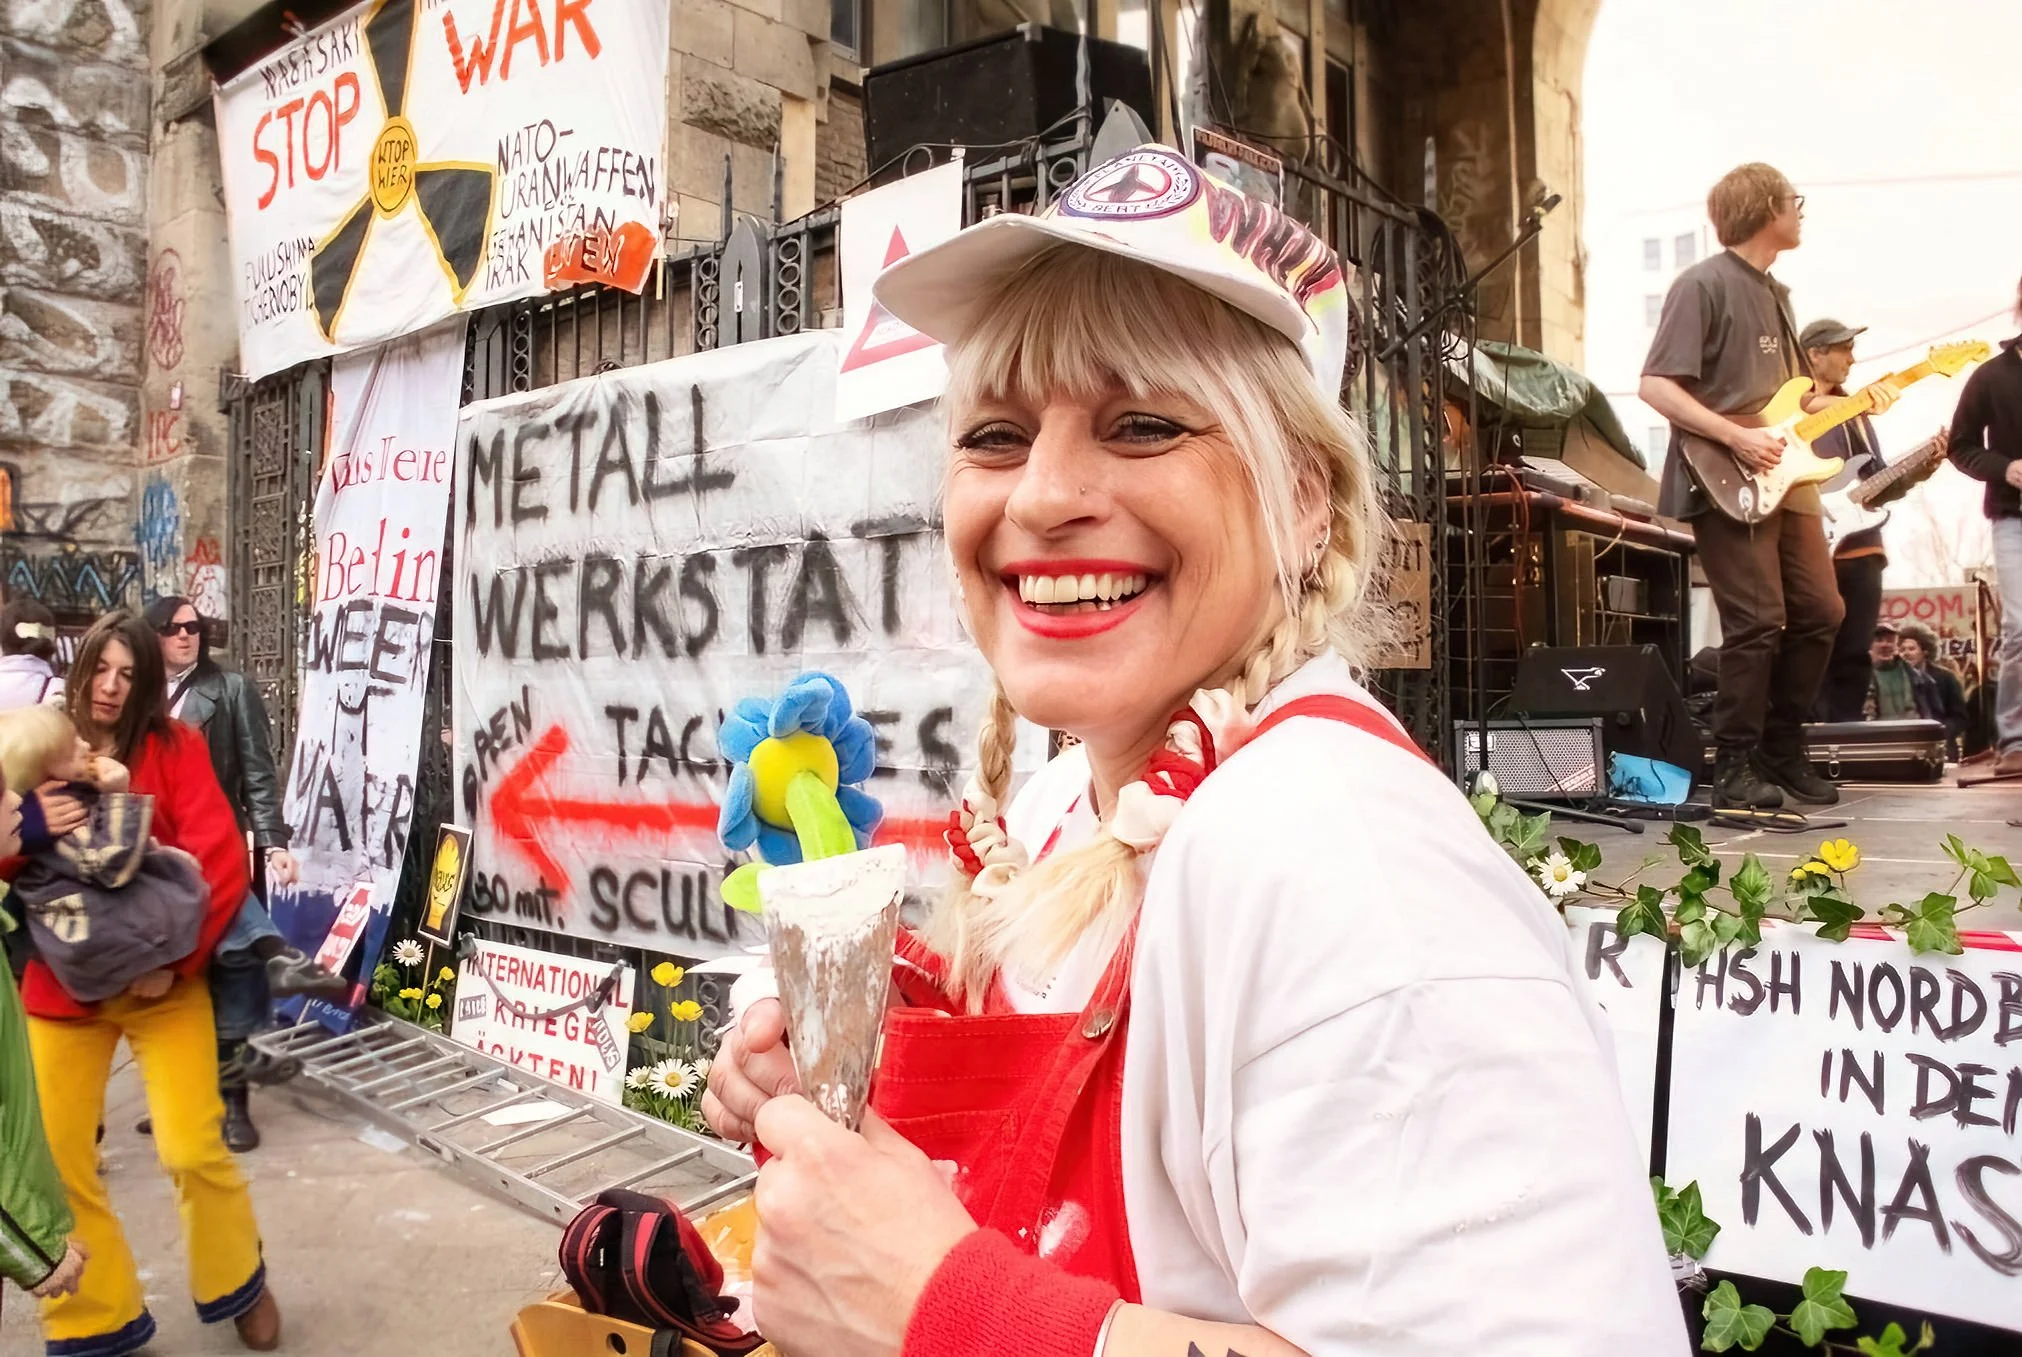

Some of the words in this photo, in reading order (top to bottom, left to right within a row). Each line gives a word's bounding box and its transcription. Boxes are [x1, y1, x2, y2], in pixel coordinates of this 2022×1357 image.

[442, 0, 602, 95] WAR
[253, 71, 360, 211] STOP
[498, 119, 573, 176] NATO-
[485, 249, 530, 293] IRAK
[465, 382, 735, 531] METALL
[470, 513, 943, 660] WERKSTAT
[463, 684, 532, 823] OPEN
[1694, 947, 1801, 1017] HSH
[1821, 1047, 1886, 1116] IN
